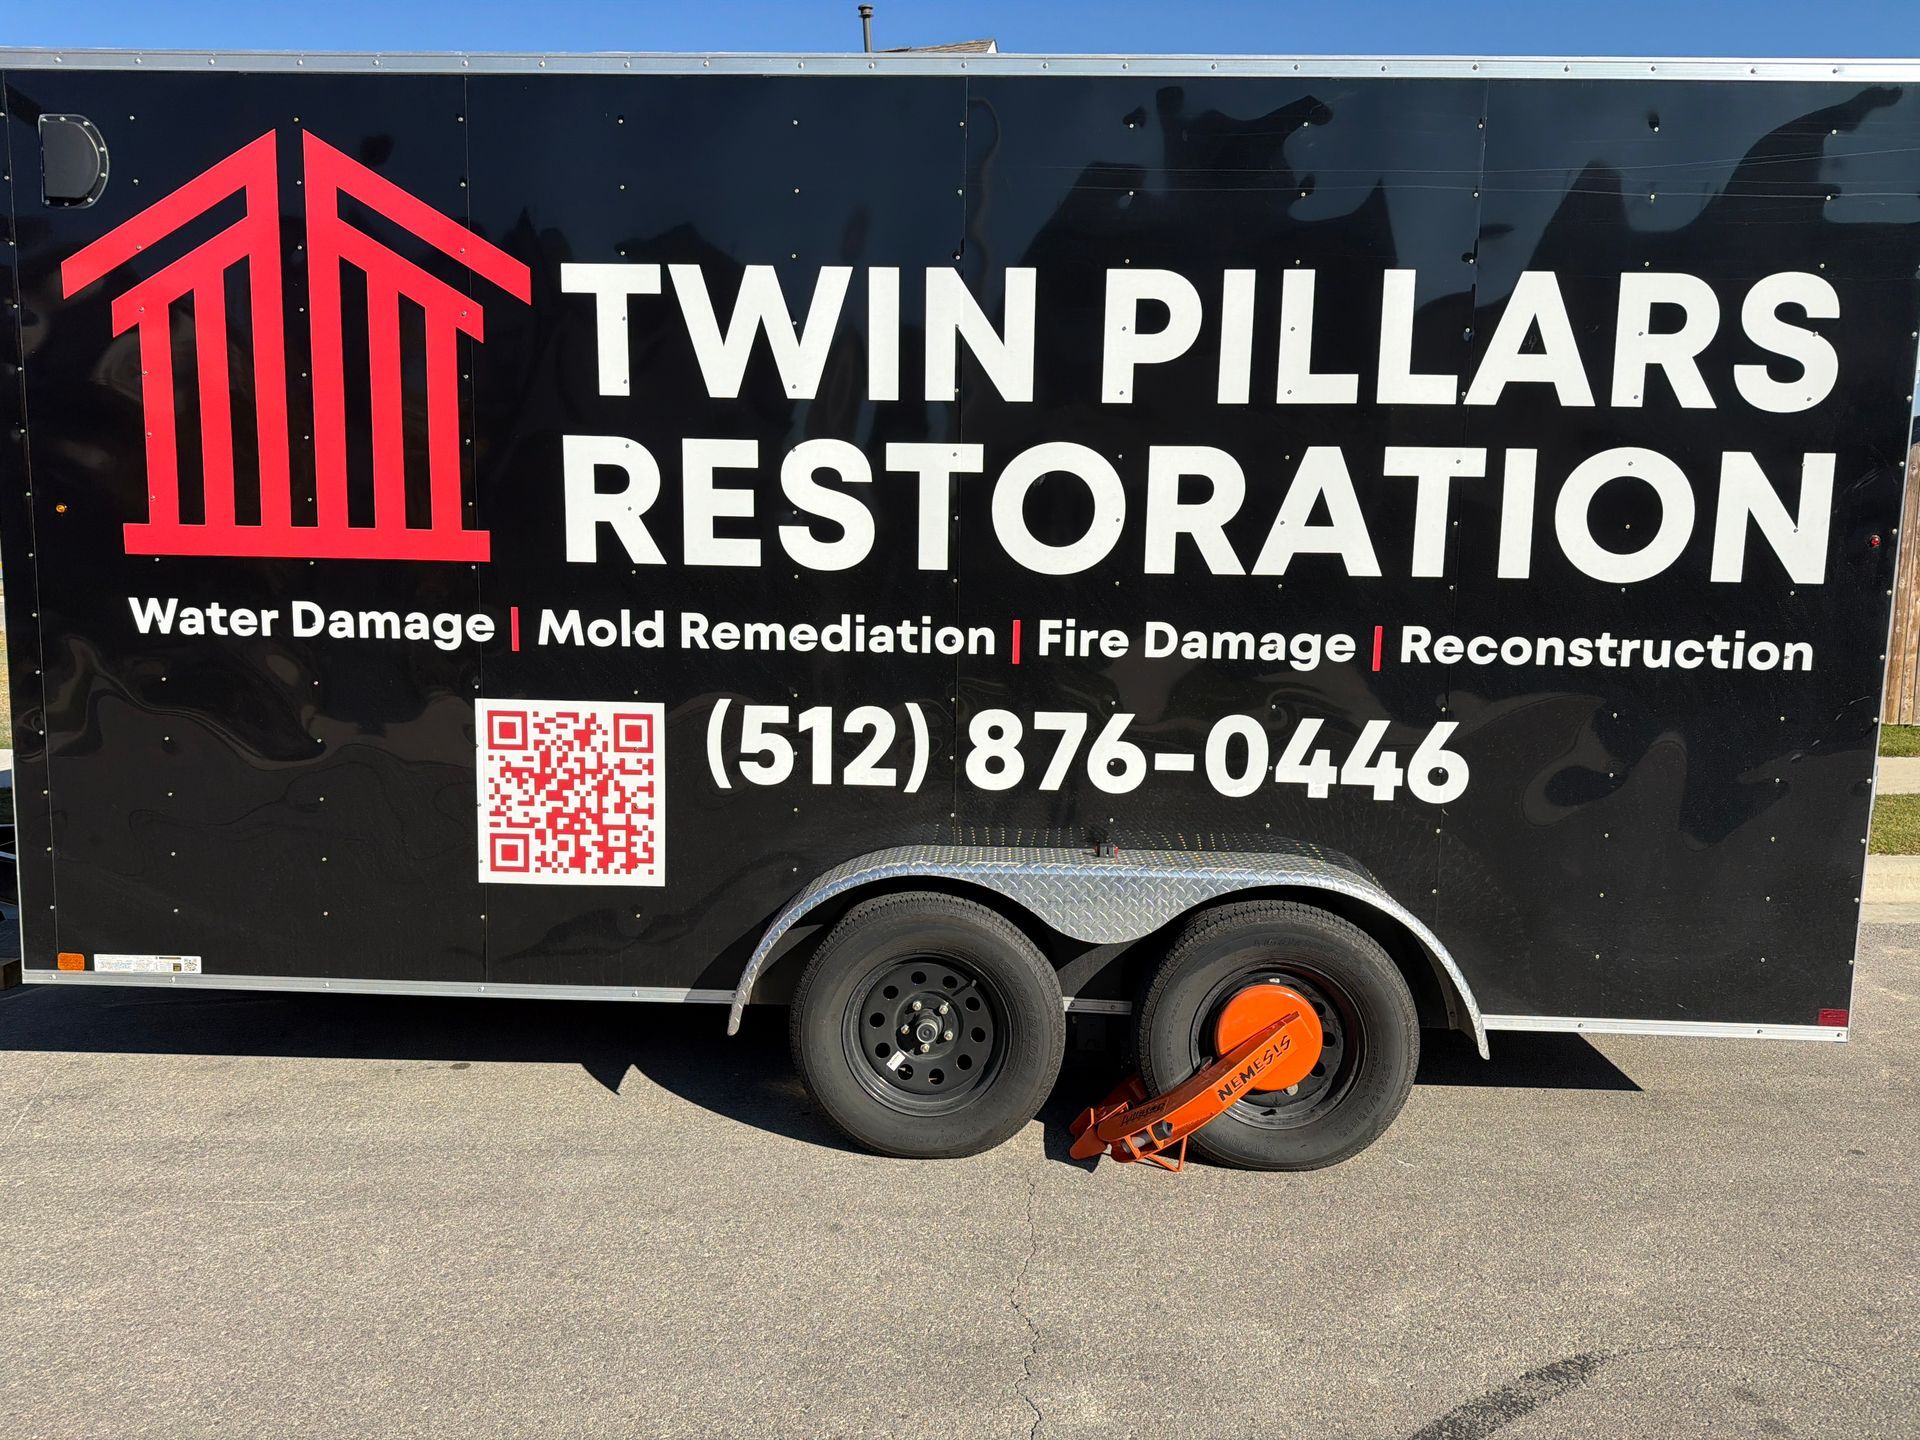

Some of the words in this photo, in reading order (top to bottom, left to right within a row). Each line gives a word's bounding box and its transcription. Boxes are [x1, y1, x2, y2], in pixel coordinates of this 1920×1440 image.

[561, 263, 1036, 403] TWIN
[1102, 269, 1840, 413] PILLARS
[563, 435, 1836, 585] RESTORATION
[128, 597, 278, 636] Water
[291, 601, 494, 651] Damage
[538, 609, 664, 648] Mold
[681, 613, 995, 655] Remediation
[1039, 619, 1129, 657] Fire
[1145, 622, 1355, 671] Damage
[1400, 626, 1813, 671] Reconstruction
[707, 699, 929, 793] (512)
[966, 709, 1470, 803] 876-0446
[1217, 1034, 1292, 1102] NEMESIS
